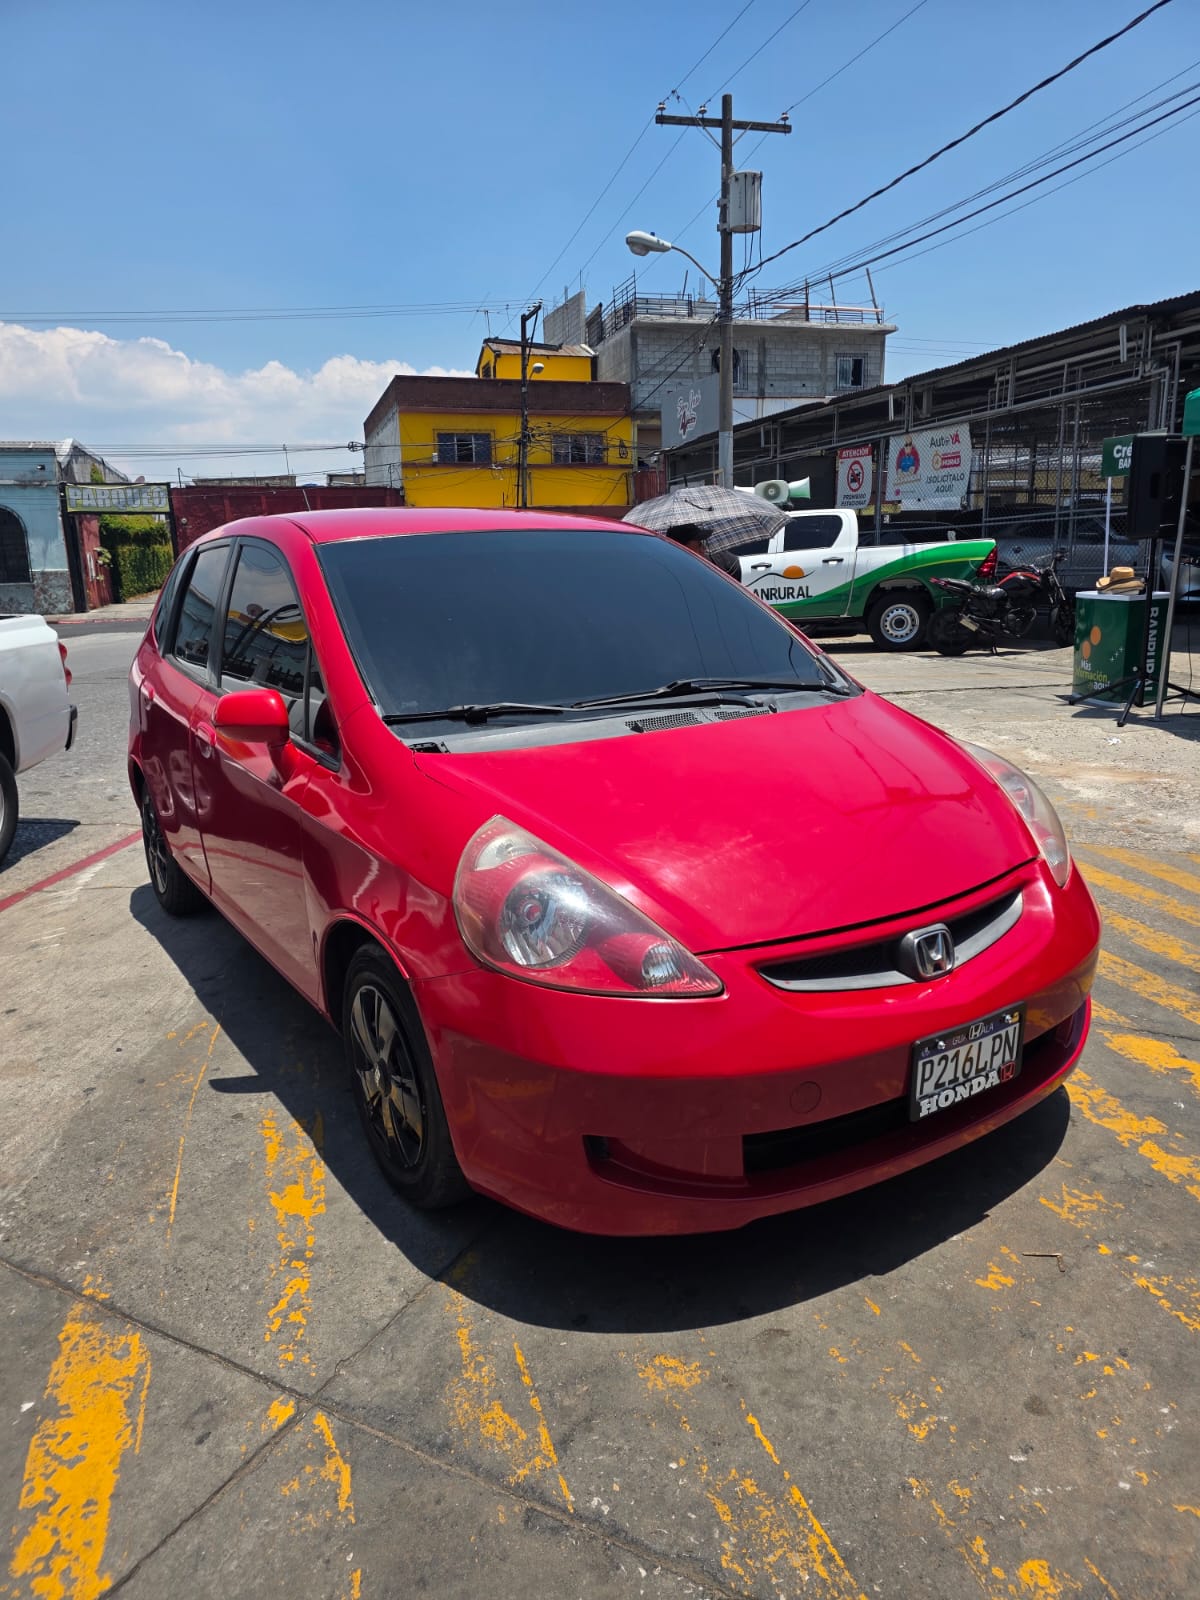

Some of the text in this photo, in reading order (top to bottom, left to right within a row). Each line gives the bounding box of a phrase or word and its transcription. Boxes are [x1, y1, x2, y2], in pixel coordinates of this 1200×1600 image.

[1113, 442, 1133, 459] Cré
[68, 486, 167, 510] PARQUEO
[920, 1028, 1017, 1096] P216LPN
[919, 1070, 1001, 1118] HONDA
